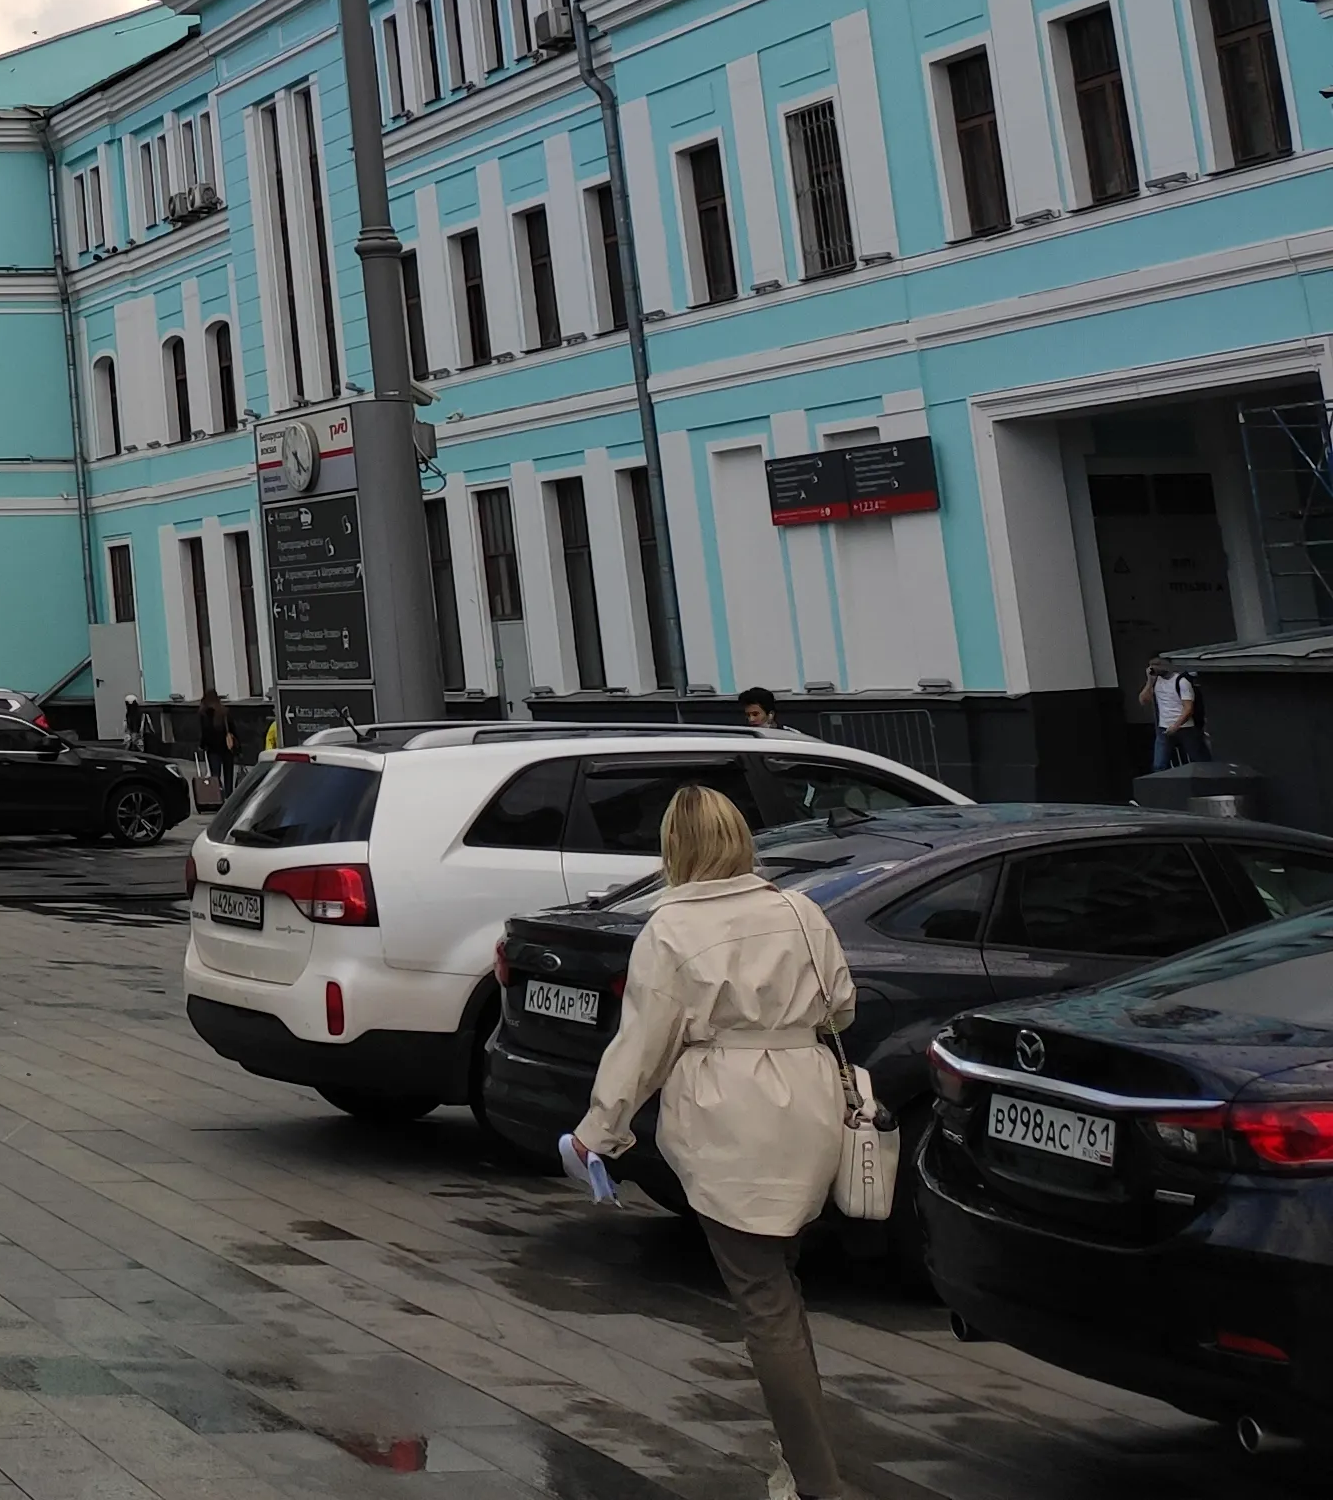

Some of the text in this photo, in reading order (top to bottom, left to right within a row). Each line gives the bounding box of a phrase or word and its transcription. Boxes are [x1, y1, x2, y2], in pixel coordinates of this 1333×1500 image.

[244, 896, 259, 914] 750
[529, 985, 597, 1015] К061АР 197
[994, 1103, 1071, 1150] В998АС
[1076, 1116, 1110, 1151] 761
